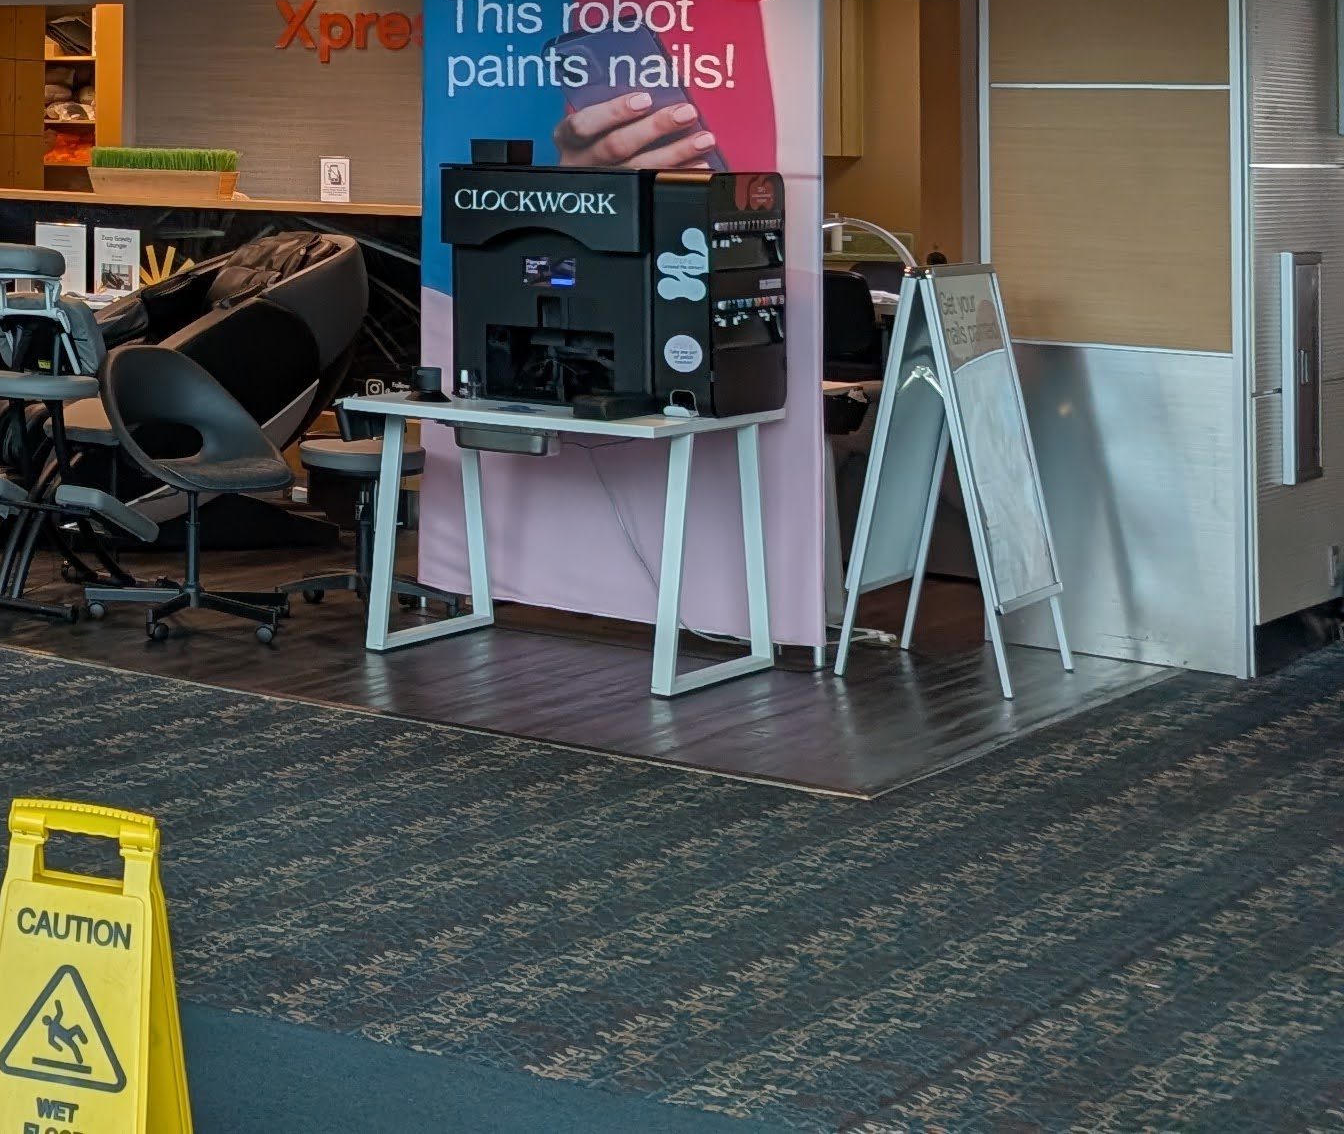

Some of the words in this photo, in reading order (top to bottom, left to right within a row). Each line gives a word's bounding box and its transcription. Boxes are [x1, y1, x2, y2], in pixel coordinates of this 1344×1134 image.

[447, 44, 588, 97] paints
[610, 43, 736, 89] nails!
[454, 189, 617, 215] CLOCKWORK
[17, 907, 132, 950] CAUTION
[36, 1097, 79, 1123] WET
